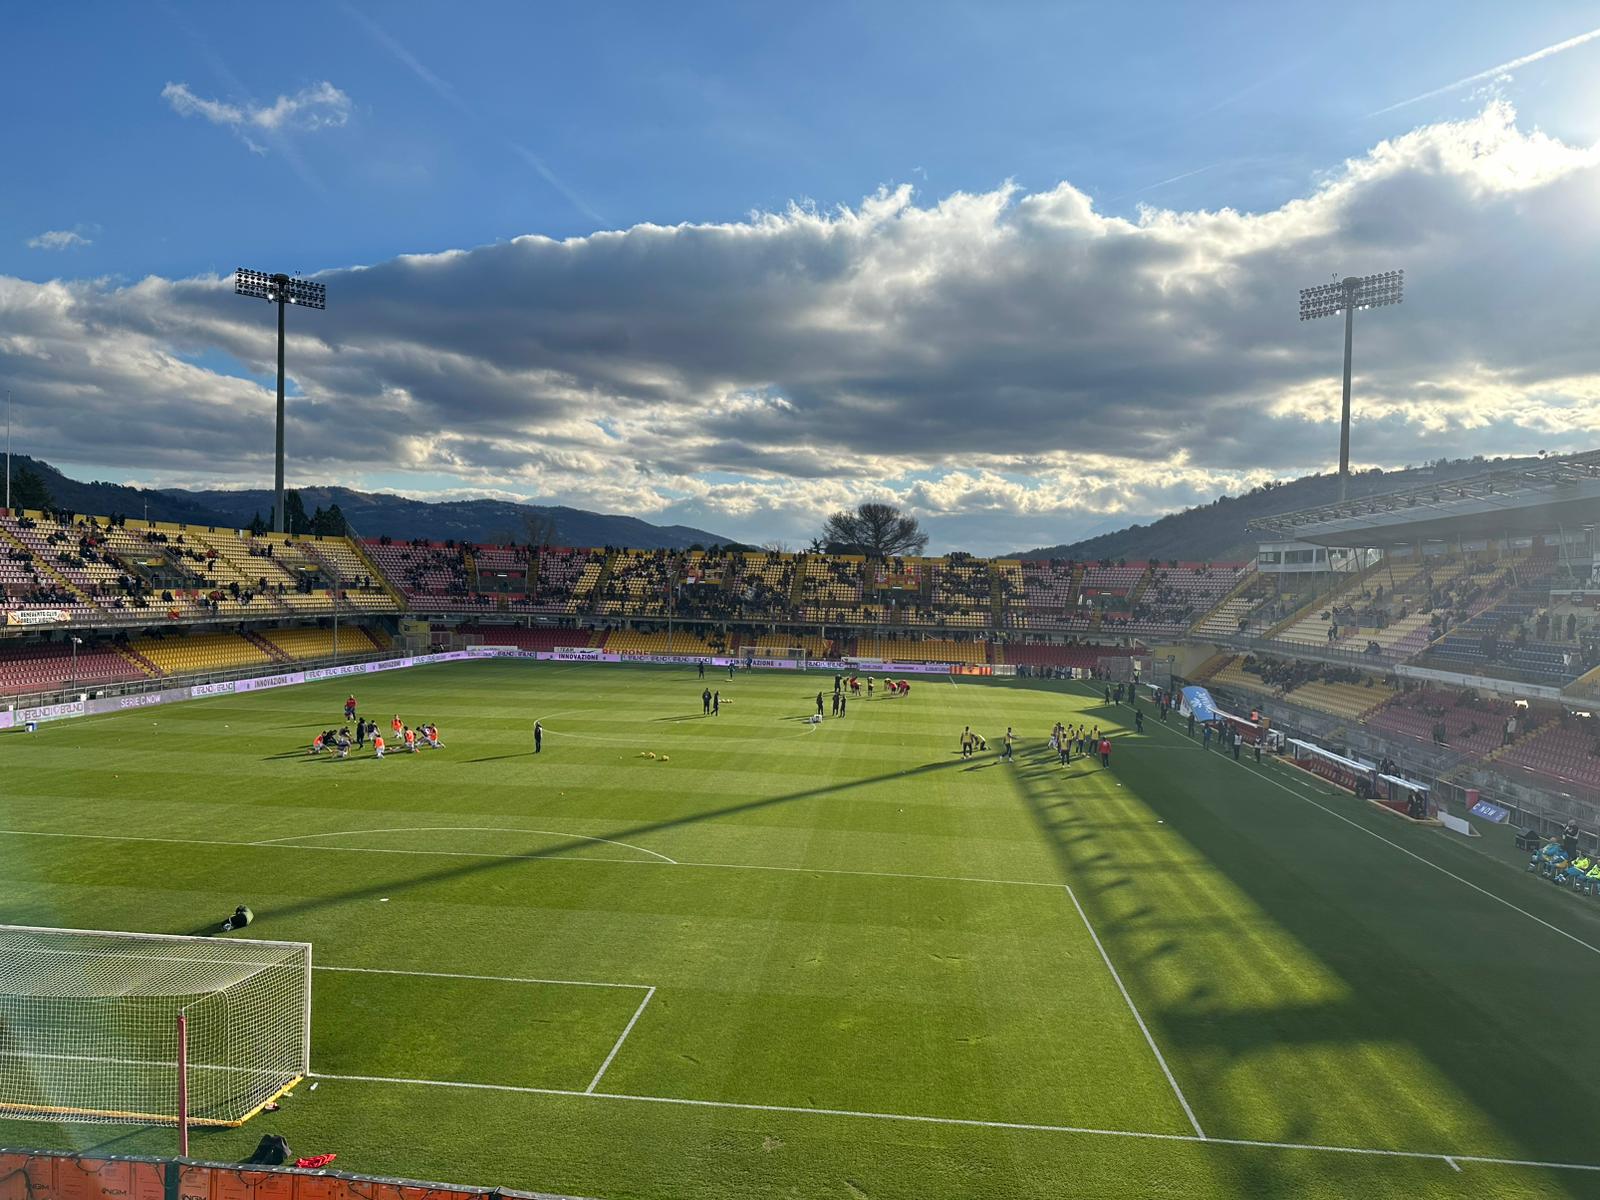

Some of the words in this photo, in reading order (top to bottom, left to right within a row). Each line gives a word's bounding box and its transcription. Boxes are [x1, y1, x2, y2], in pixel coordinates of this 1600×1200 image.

[254, 676, 288, 688] INNOVAZIONE
[120, 698, 140, 708] SERIE
[140, 696, 146, 706] C
[146, 694, 161, 704] NOW
